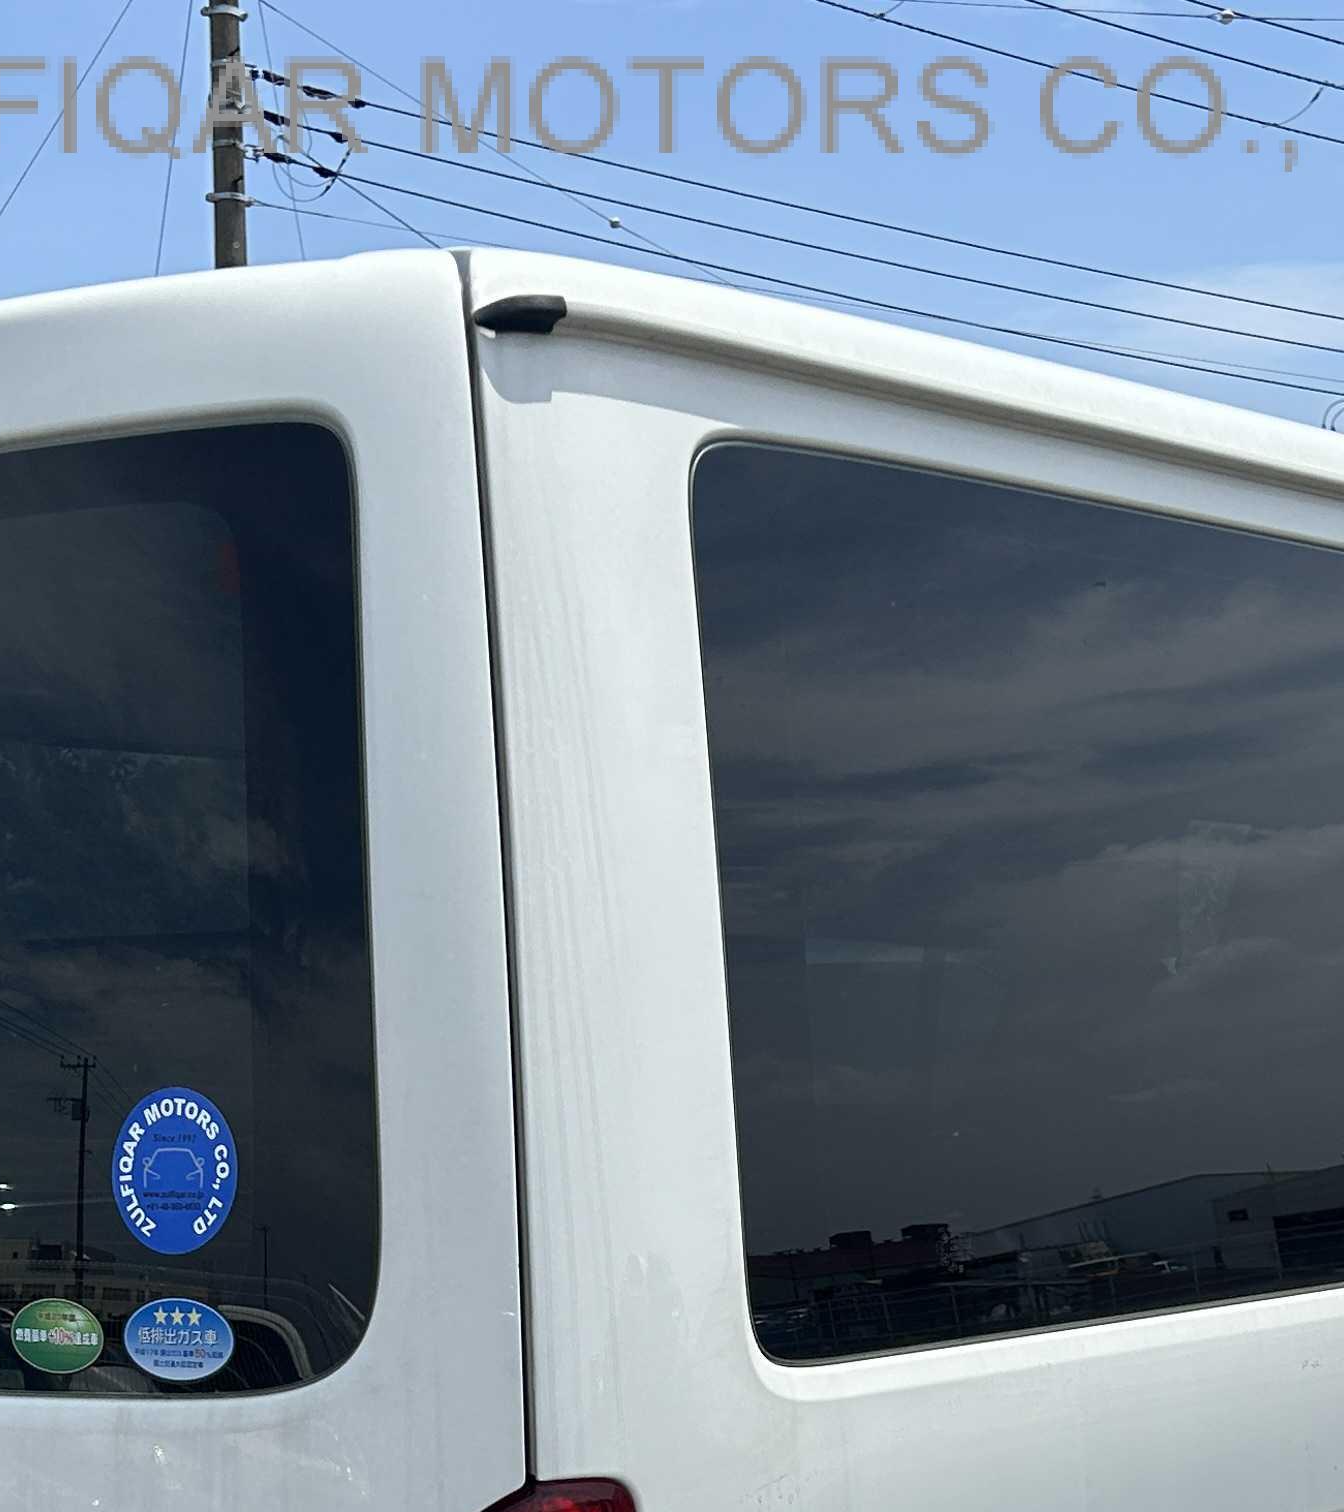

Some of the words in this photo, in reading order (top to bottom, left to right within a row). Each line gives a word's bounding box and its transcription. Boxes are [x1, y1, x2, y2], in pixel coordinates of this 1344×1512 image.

[119, 1121, 157, 1238] ZULFIQAR
[143, 1098, 220, 1140] MOTORS
[193, 1196, 223, 1235] LTD
[138, 1326, 219, 1346] 低排出ガス車
